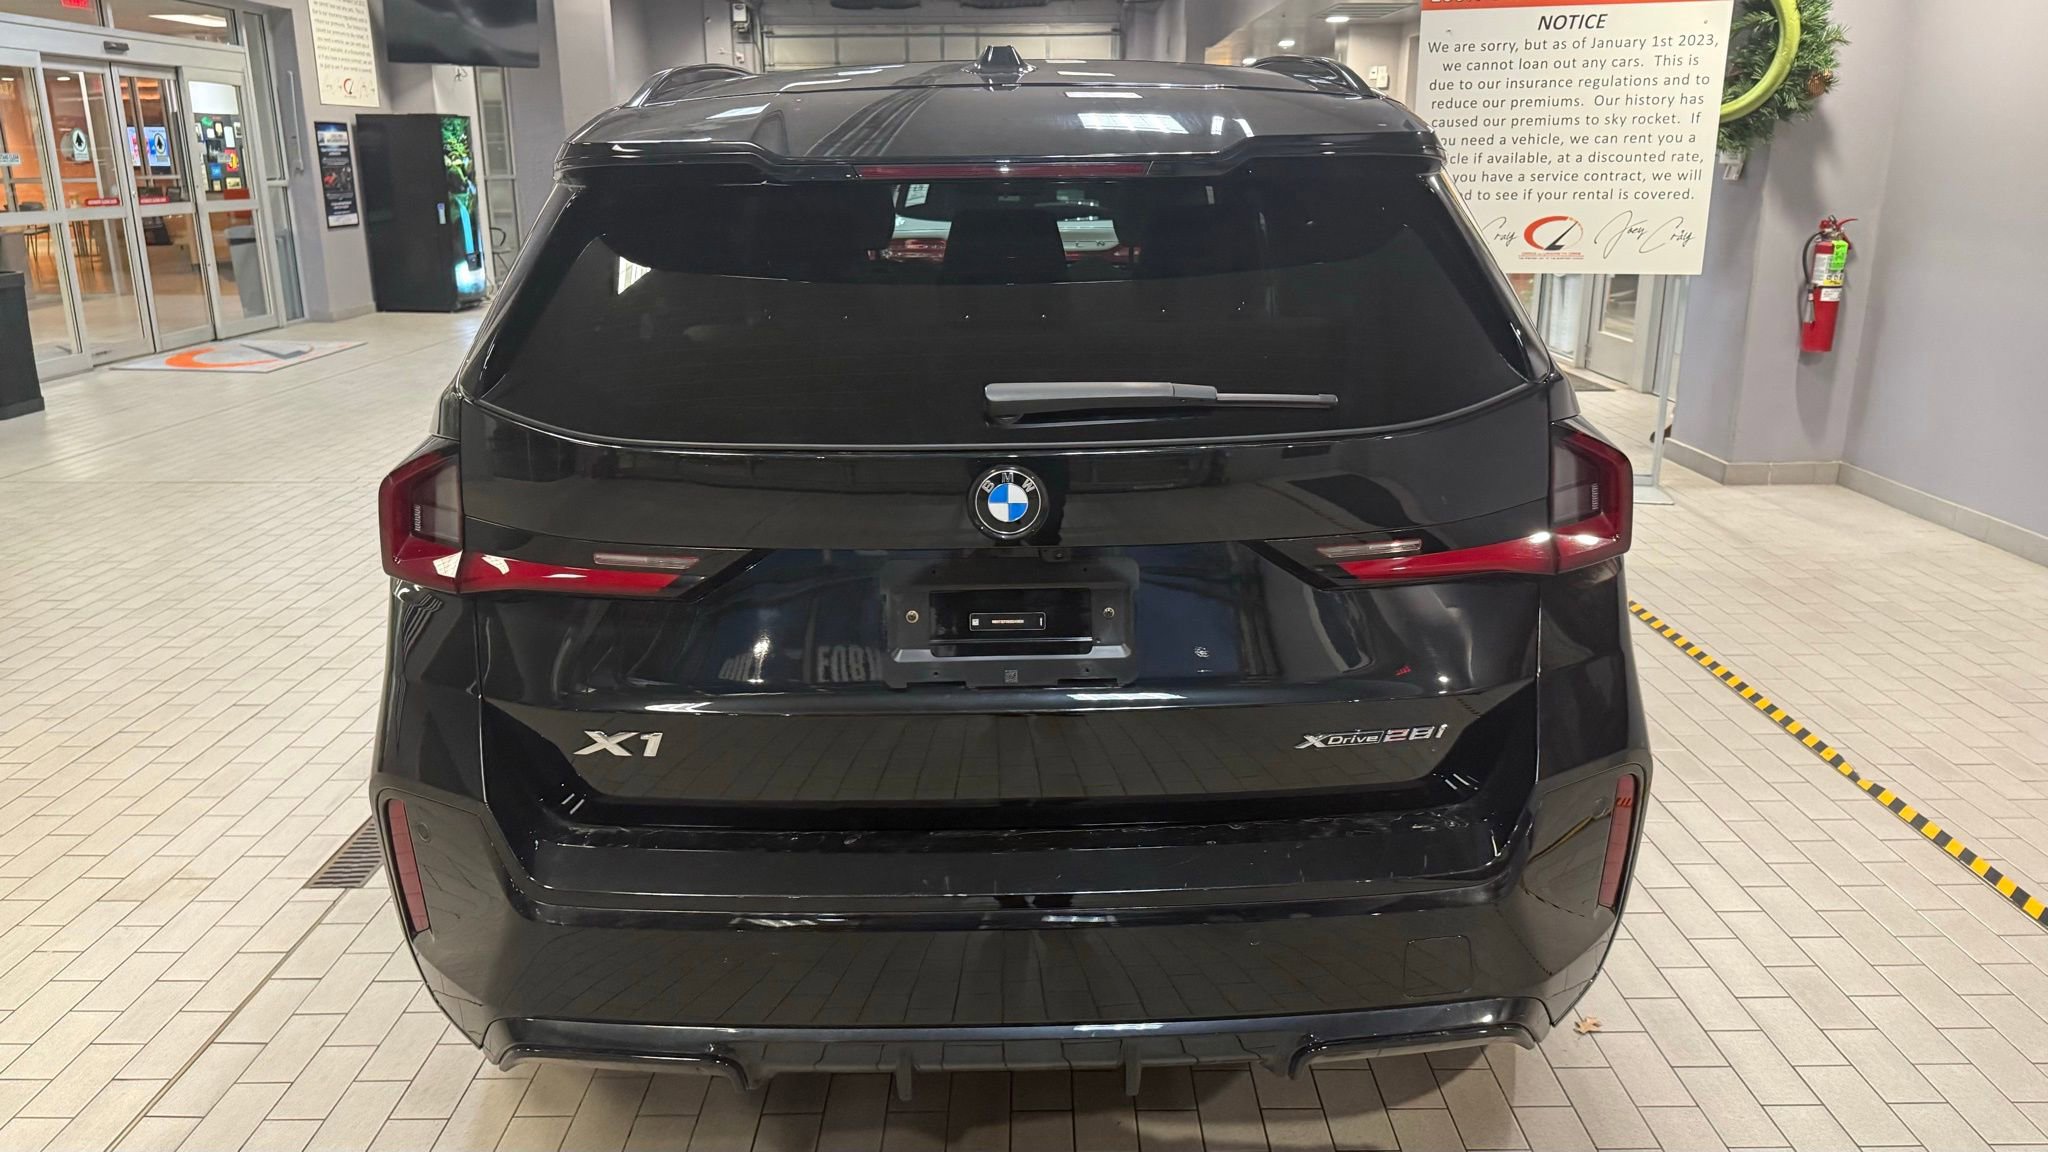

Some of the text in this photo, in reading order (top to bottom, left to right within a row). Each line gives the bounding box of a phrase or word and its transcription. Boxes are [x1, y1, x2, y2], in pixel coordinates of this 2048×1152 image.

[1537, 14, 1608, 30] NOTICE
[1428, 34, 1718, 54] We are sorry, but as of January 1st 2023,
[1442, 54, 1699, 72] we cannot loan out any cars. This is
[1429, 73, 1710, 91] due to our insurance regulations and to
[1431, 93, 1704, 111] reduce our premiums. Our history has
[1431, 111, 1702, 129] caused our premiums to sky rocket. If
[1440, 133, 1696, 146] ou need a vehicle, we can rent you a
[1473, 152, 1483, 164] if
[1487, 152, 1552, 165] available,
[1557, 153, 1570, 163] at
[1575, 154, 1583, 163] a
[1588, 150, 1666, 163] discounted
[1671, 152, 1703, 164] rate,
[1453, 169, 1702, 184] you have a service contract, we will
[1477, 190, 1491, 200] to
[1496, 192, 1518, 200] see
[1523, 188, 1533, 200] if
[1537, 191, 1568, 203] your
[1572, 188, 1613, 200] rental
[1618, 188, 1629, 200] is
[1634, 188, 1694, 200] covered.
[982, 472, 1036, 493] BMW
[573, 731, 664, 757] X1
